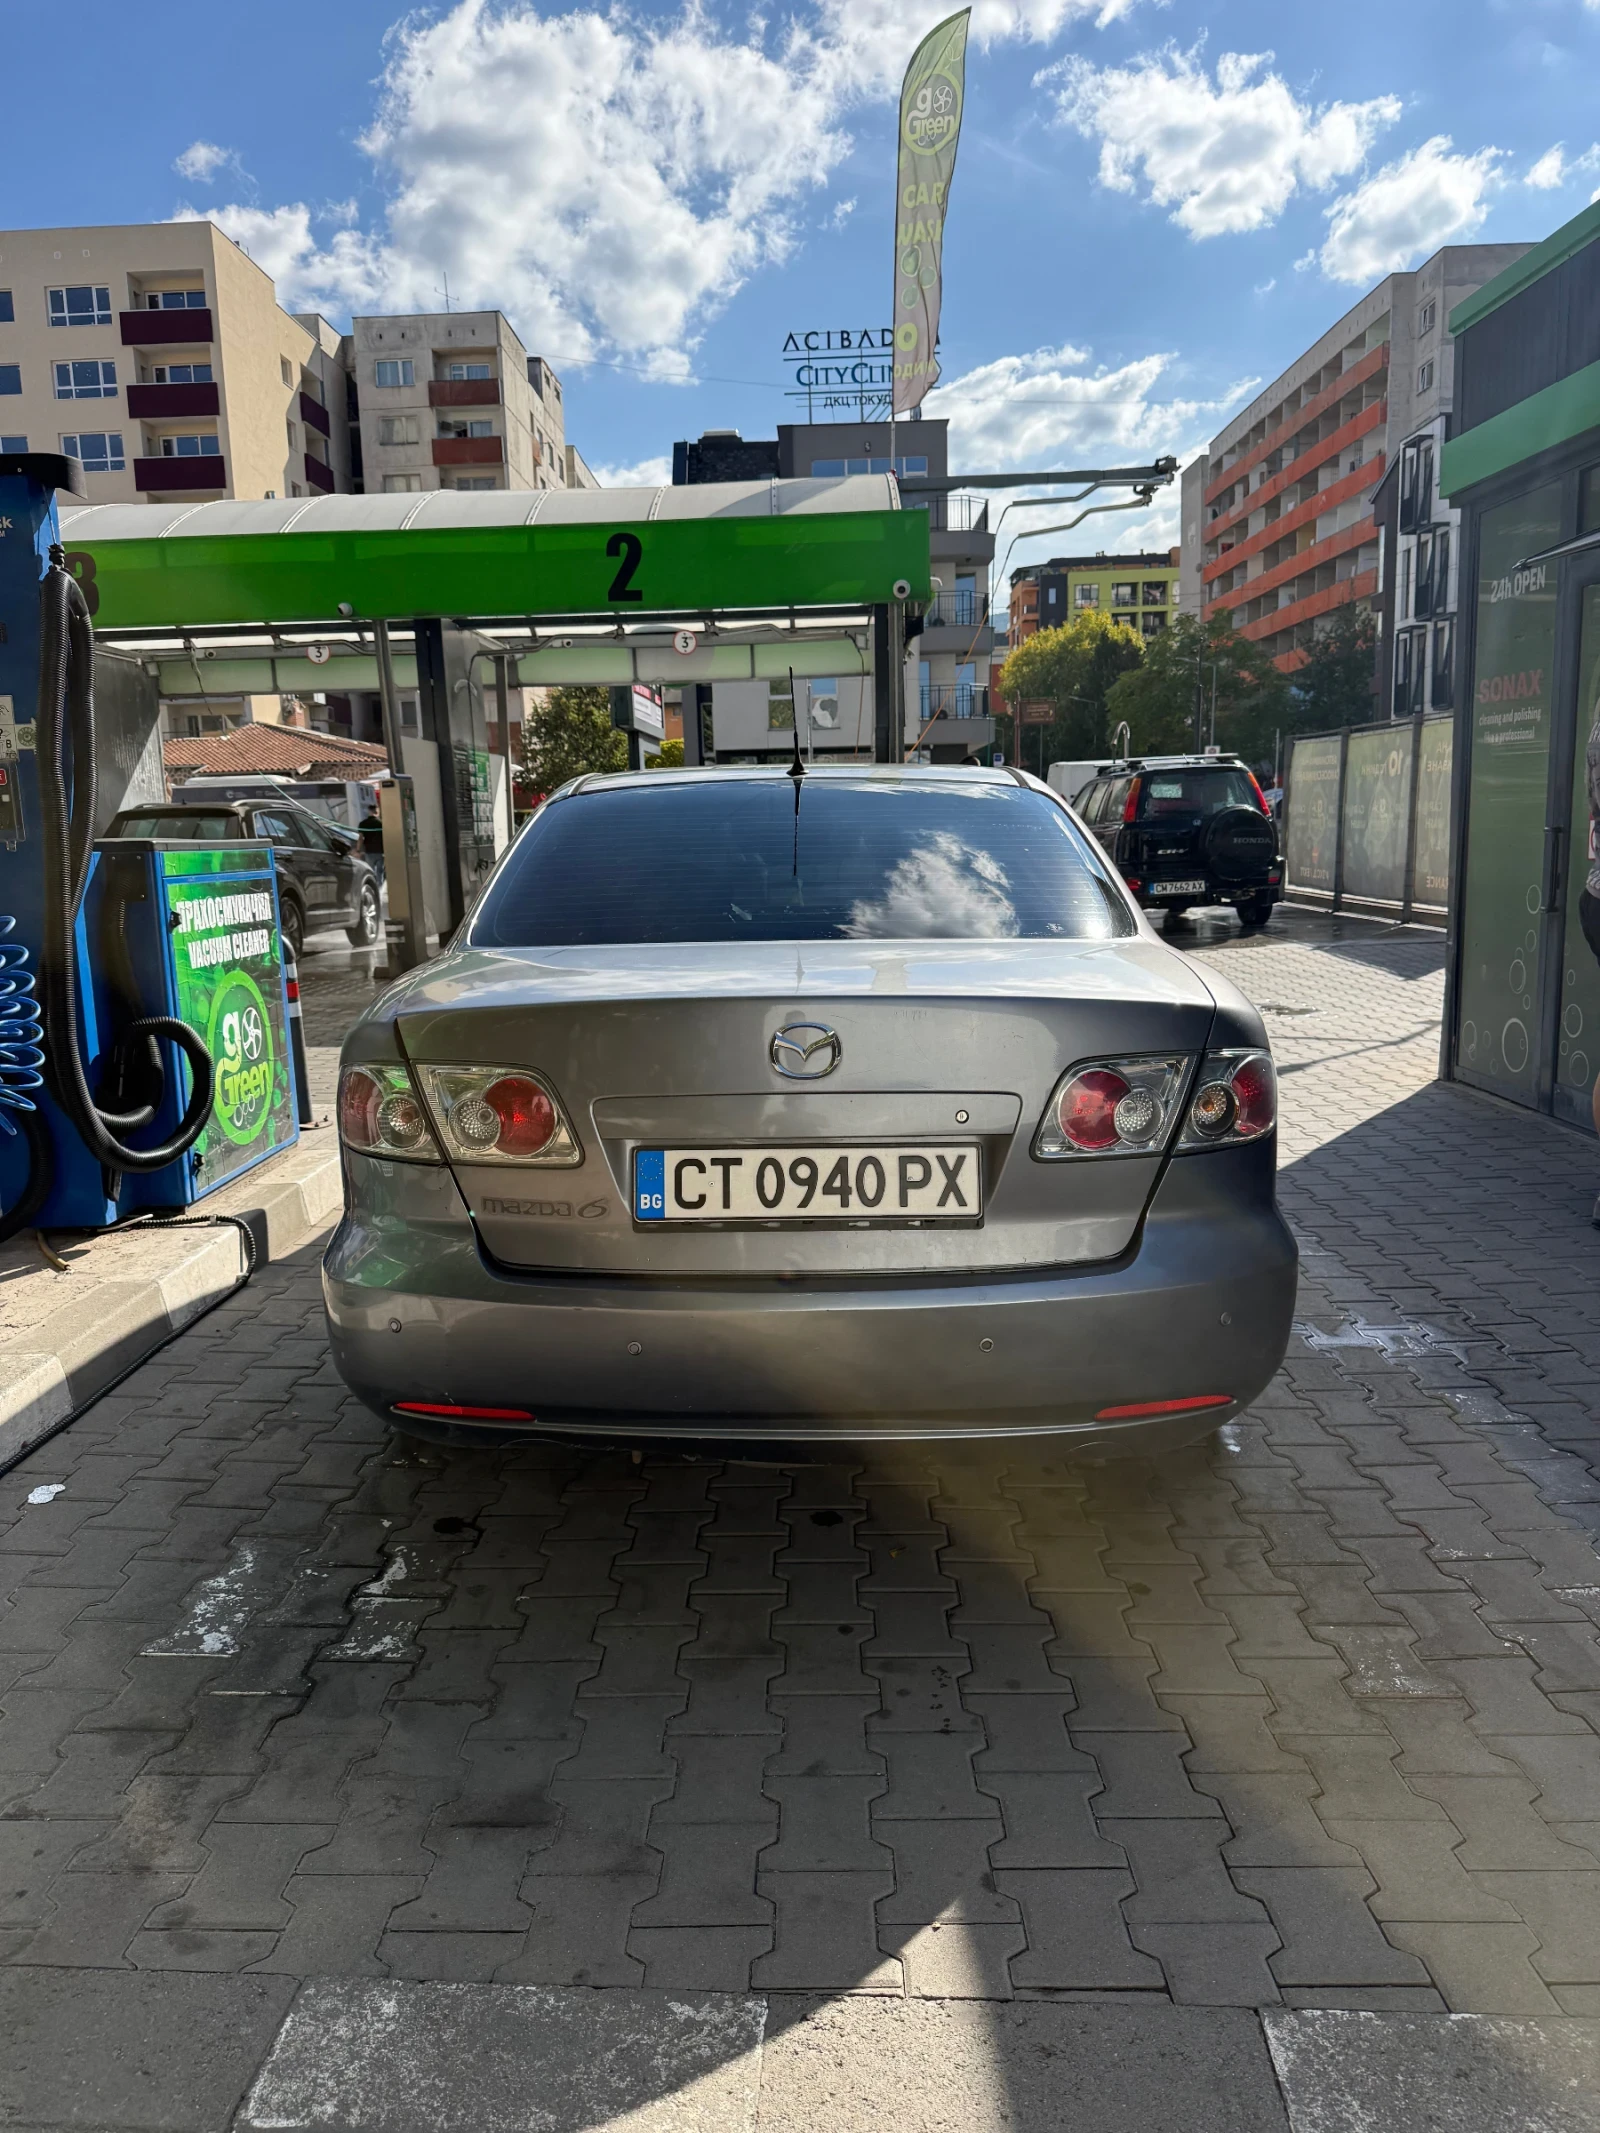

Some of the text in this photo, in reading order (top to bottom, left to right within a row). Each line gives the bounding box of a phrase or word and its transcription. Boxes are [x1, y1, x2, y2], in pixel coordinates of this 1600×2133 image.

[905, 110, 955, 141] Green
[903, 182, 945, 209] CAR
[783, 328, 940, 352] ACIBAD
[824, 394, 893, 409] ДКЦ ТОКУД
[606, 533, 643, 602] 2
[1491, 565, 1546, 603] 24h OPEN
[1479, 669, 1542, 704] SONAX
[1479, 706, 1542, 727] cleaning and polishing
[1500, 726, 1535, 746] professional
[1233, 836, 1271, 844] HONDA
[187, 929, 270, 970] VACUUM CLEANER
[214, 1057, 271, 1119] Green
[640, 1154, 968, 1210] BG CT 0940 PX
